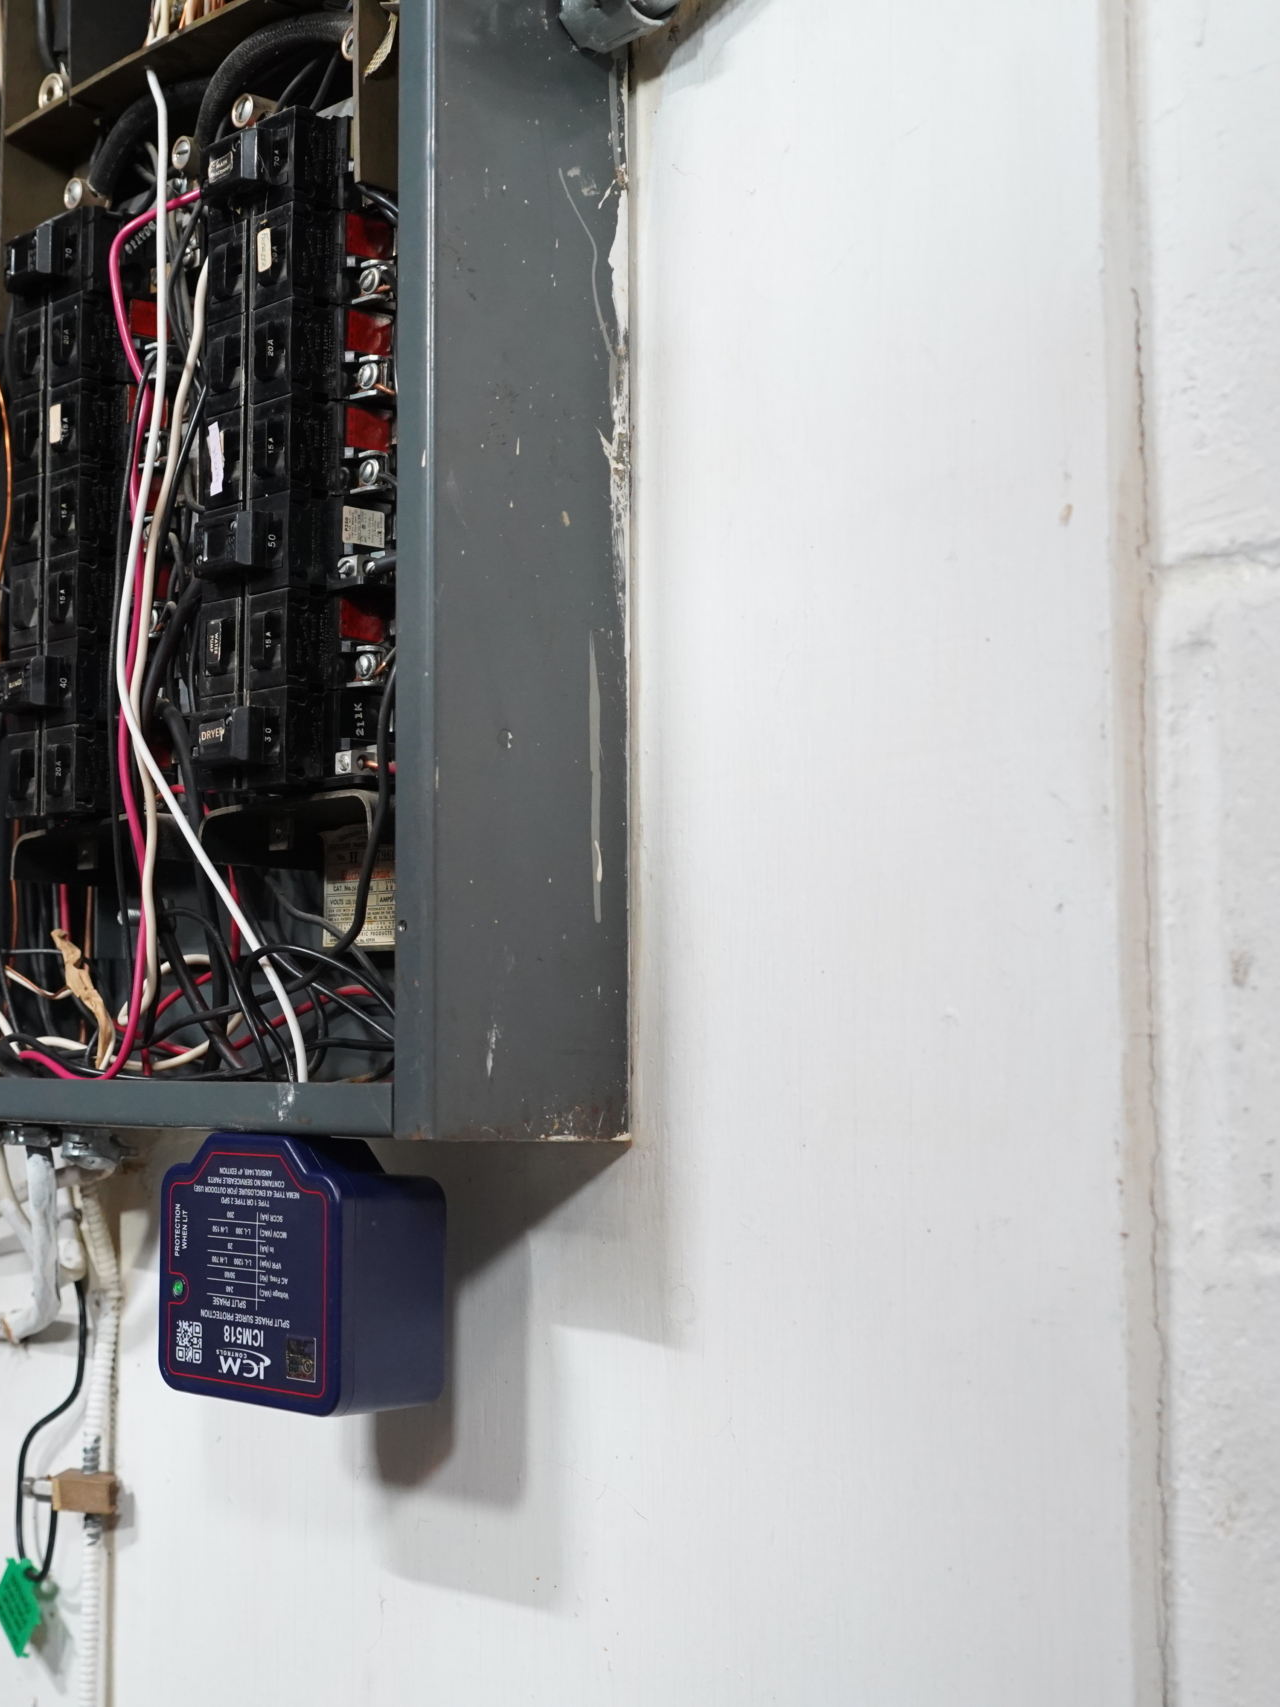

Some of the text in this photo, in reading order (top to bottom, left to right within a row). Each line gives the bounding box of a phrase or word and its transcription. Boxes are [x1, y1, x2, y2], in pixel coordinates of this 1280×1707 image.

[65, 248, 72, 259] 70
[268, 534, 276, 548] 50
[60, 677, 67, 689] 40
[265, 728, 272, 742] 30
[349, 852, 358, 863] H
[219, 1167, 237, 1175] EDITION
[208, 1176, 285, 1188] CONTAINS NO SERVICEABLE PARTS
[194, 1184, 204, 1192] USE)
[205, 1186, 227, 1194] OUTDOOR
[227, 1186, 238, 1195] (FOR
[239, 1188, 266, 1197] ENCLOSURE
[273, 1190, 285, 1198] TYPE
[286, 1191, 300, 1199] NEMA
[221, 1196, 230, 1204] SPD
[258, 1199, 270, 1207] TYPE
[270, 1215, 283, 1223] SCCR
[235, 1227, 243, 1235] 300
[273, 1231, 287, 1239] MCOV
[224, 1271, 236, 1279] 50/60
[281, 1277, 288, 1285] AC
[259, 1288, 272, 1298] (VAC)
[272, 1289, 289, 1300] Voltage
[213, 1297, 247, 1309] SPLIT PHASE
[200, 1309, 290, 1329] SPLIT PHASE SURGE PROTECTION
[224, 1325, 264, 1348] ICM518
[216, 1349, 247, 1359] CONTROLS
[219, 1356, 265, 1380] ICM
